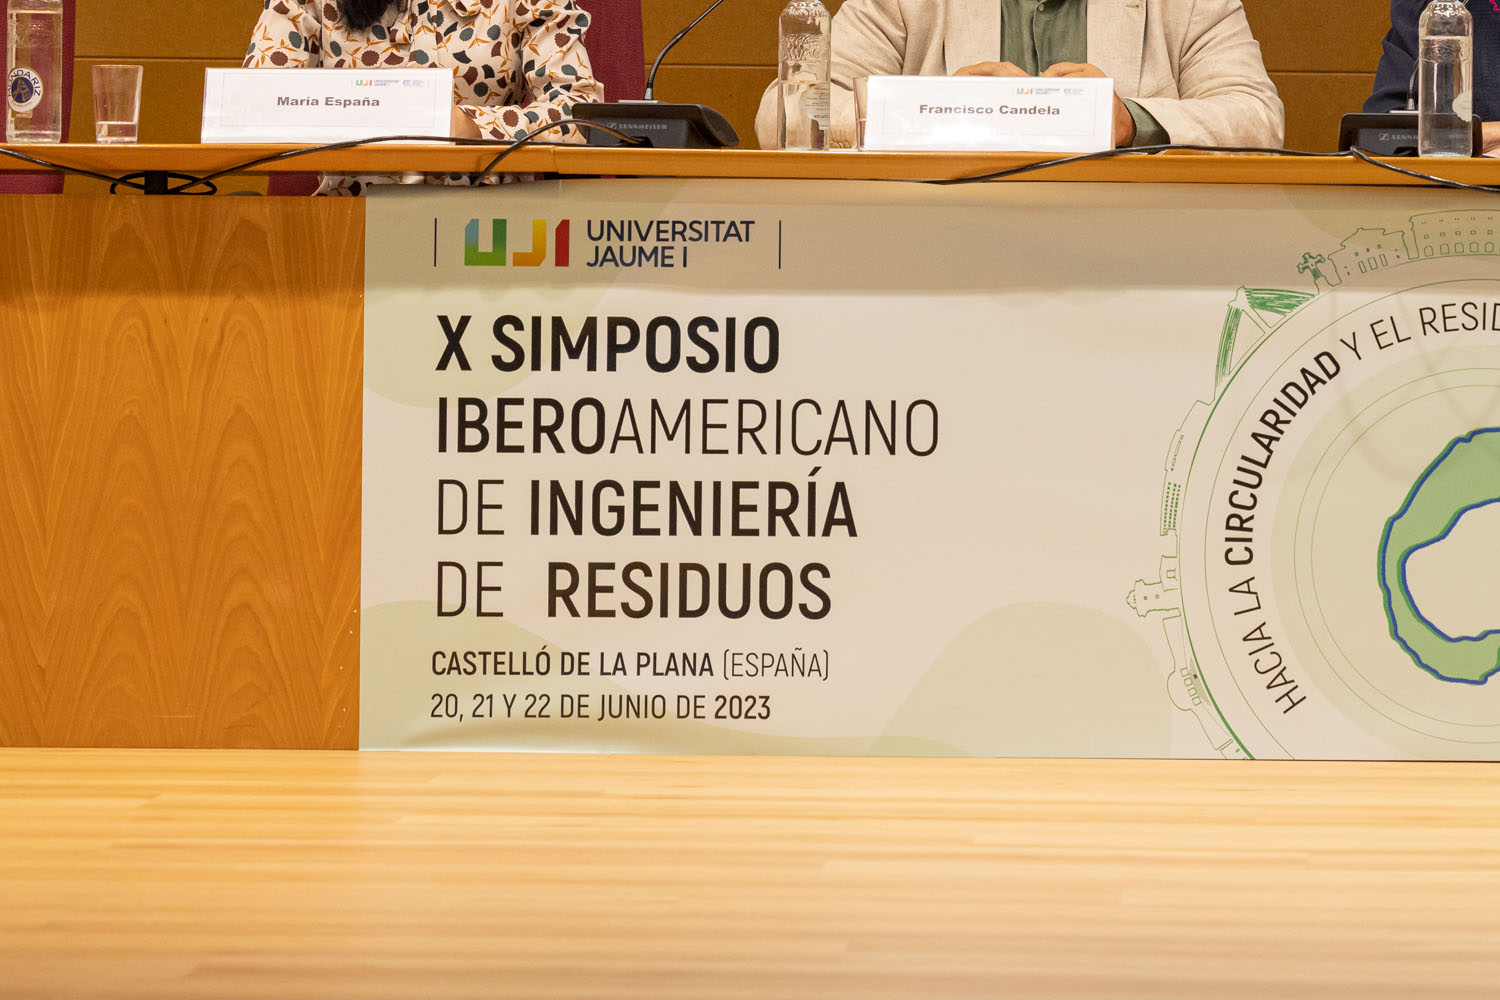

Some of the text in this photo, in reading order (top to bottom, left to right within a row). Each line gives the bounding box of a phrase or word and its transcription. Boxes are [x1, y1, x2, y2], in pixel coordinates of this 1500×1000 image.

[277, 96, 380, 109] María España
[919, 104, 1060, 115] Francisco Candela
[464, 218, 570, 267] UJI
[587, 219, 755, 242] UNIVERSITAT
[586, 245, 674, 268] JAUME
[435, 315, 780, 373] X SIMPOSIO
[1341, 331, 1364, 361] Y
[1370, 316, 1411, 350] EL
[438, 398, 939, 456] IBEROAMERICANO
[1223, 350, 1341, 565] CIRCULARIDAD
[438, 467, 858, 538] DE INGENIERÍA
[437, 561, 831, 619] DE RESIDUOS
[1228, 575, 1260, 617] LA
[431, 645, 830, 681] CASTELLÓ DE LA PLANA (ESPAÑA)
[1244, 621, 1307, 714] HACIA
[431, 694, 771, 722] 20, 21 Y 22 DE JUNIO DE 2023
